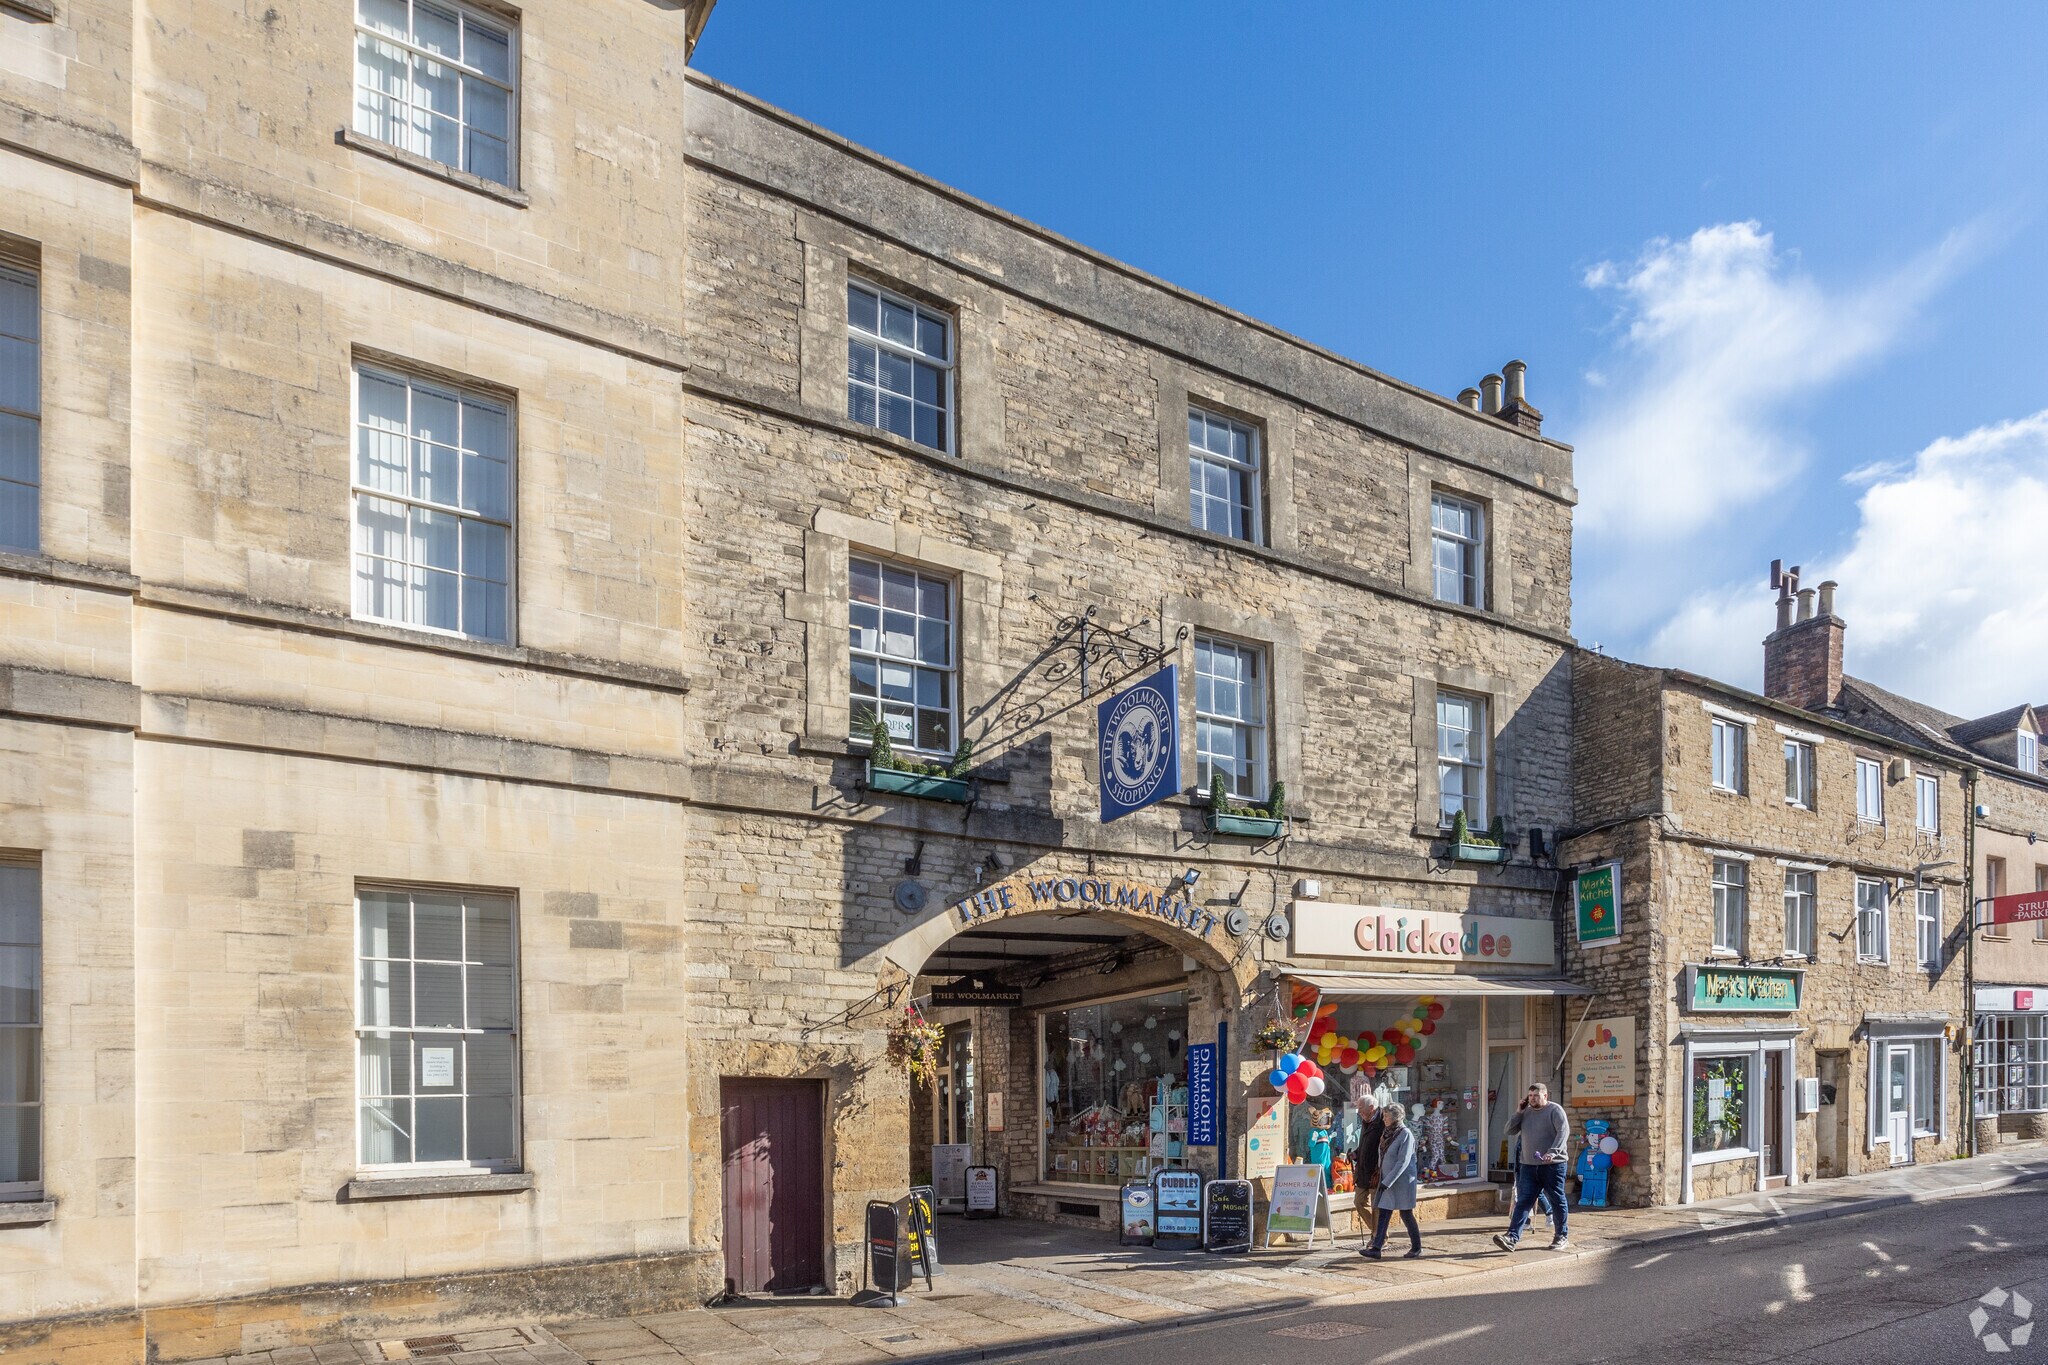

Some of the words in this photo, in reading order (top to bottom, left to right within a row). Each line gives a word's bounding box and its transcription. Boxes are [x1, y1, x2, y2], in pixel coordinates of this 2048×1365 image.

[885, 719, 905, 730] QPR
[1104, 730, 1116, 763] THE
[1111, 690, 1170, 734] WOOLMARKET
[1112, 764, 1162, 802] SHOPPING
[1581, 875, 1612, 890] Mark's
[959, 886, 1017, 922] THE
[1030, 879, 1221, 935] WOOLMARKET
[1354, 914, 1512, 957] Chickadee
[1707, 974, 1745, 998] Mark's
[1747, 975, 1788, 998] Kitchen
[1584, 1053, 1623, 1062] Chickadee
[1200, 1048, 1210, 1142] SHOPPING
[1161, 1177, 1198, 1188] BUBBLES
[1212, 1194, 1229, 1202] Cafe
